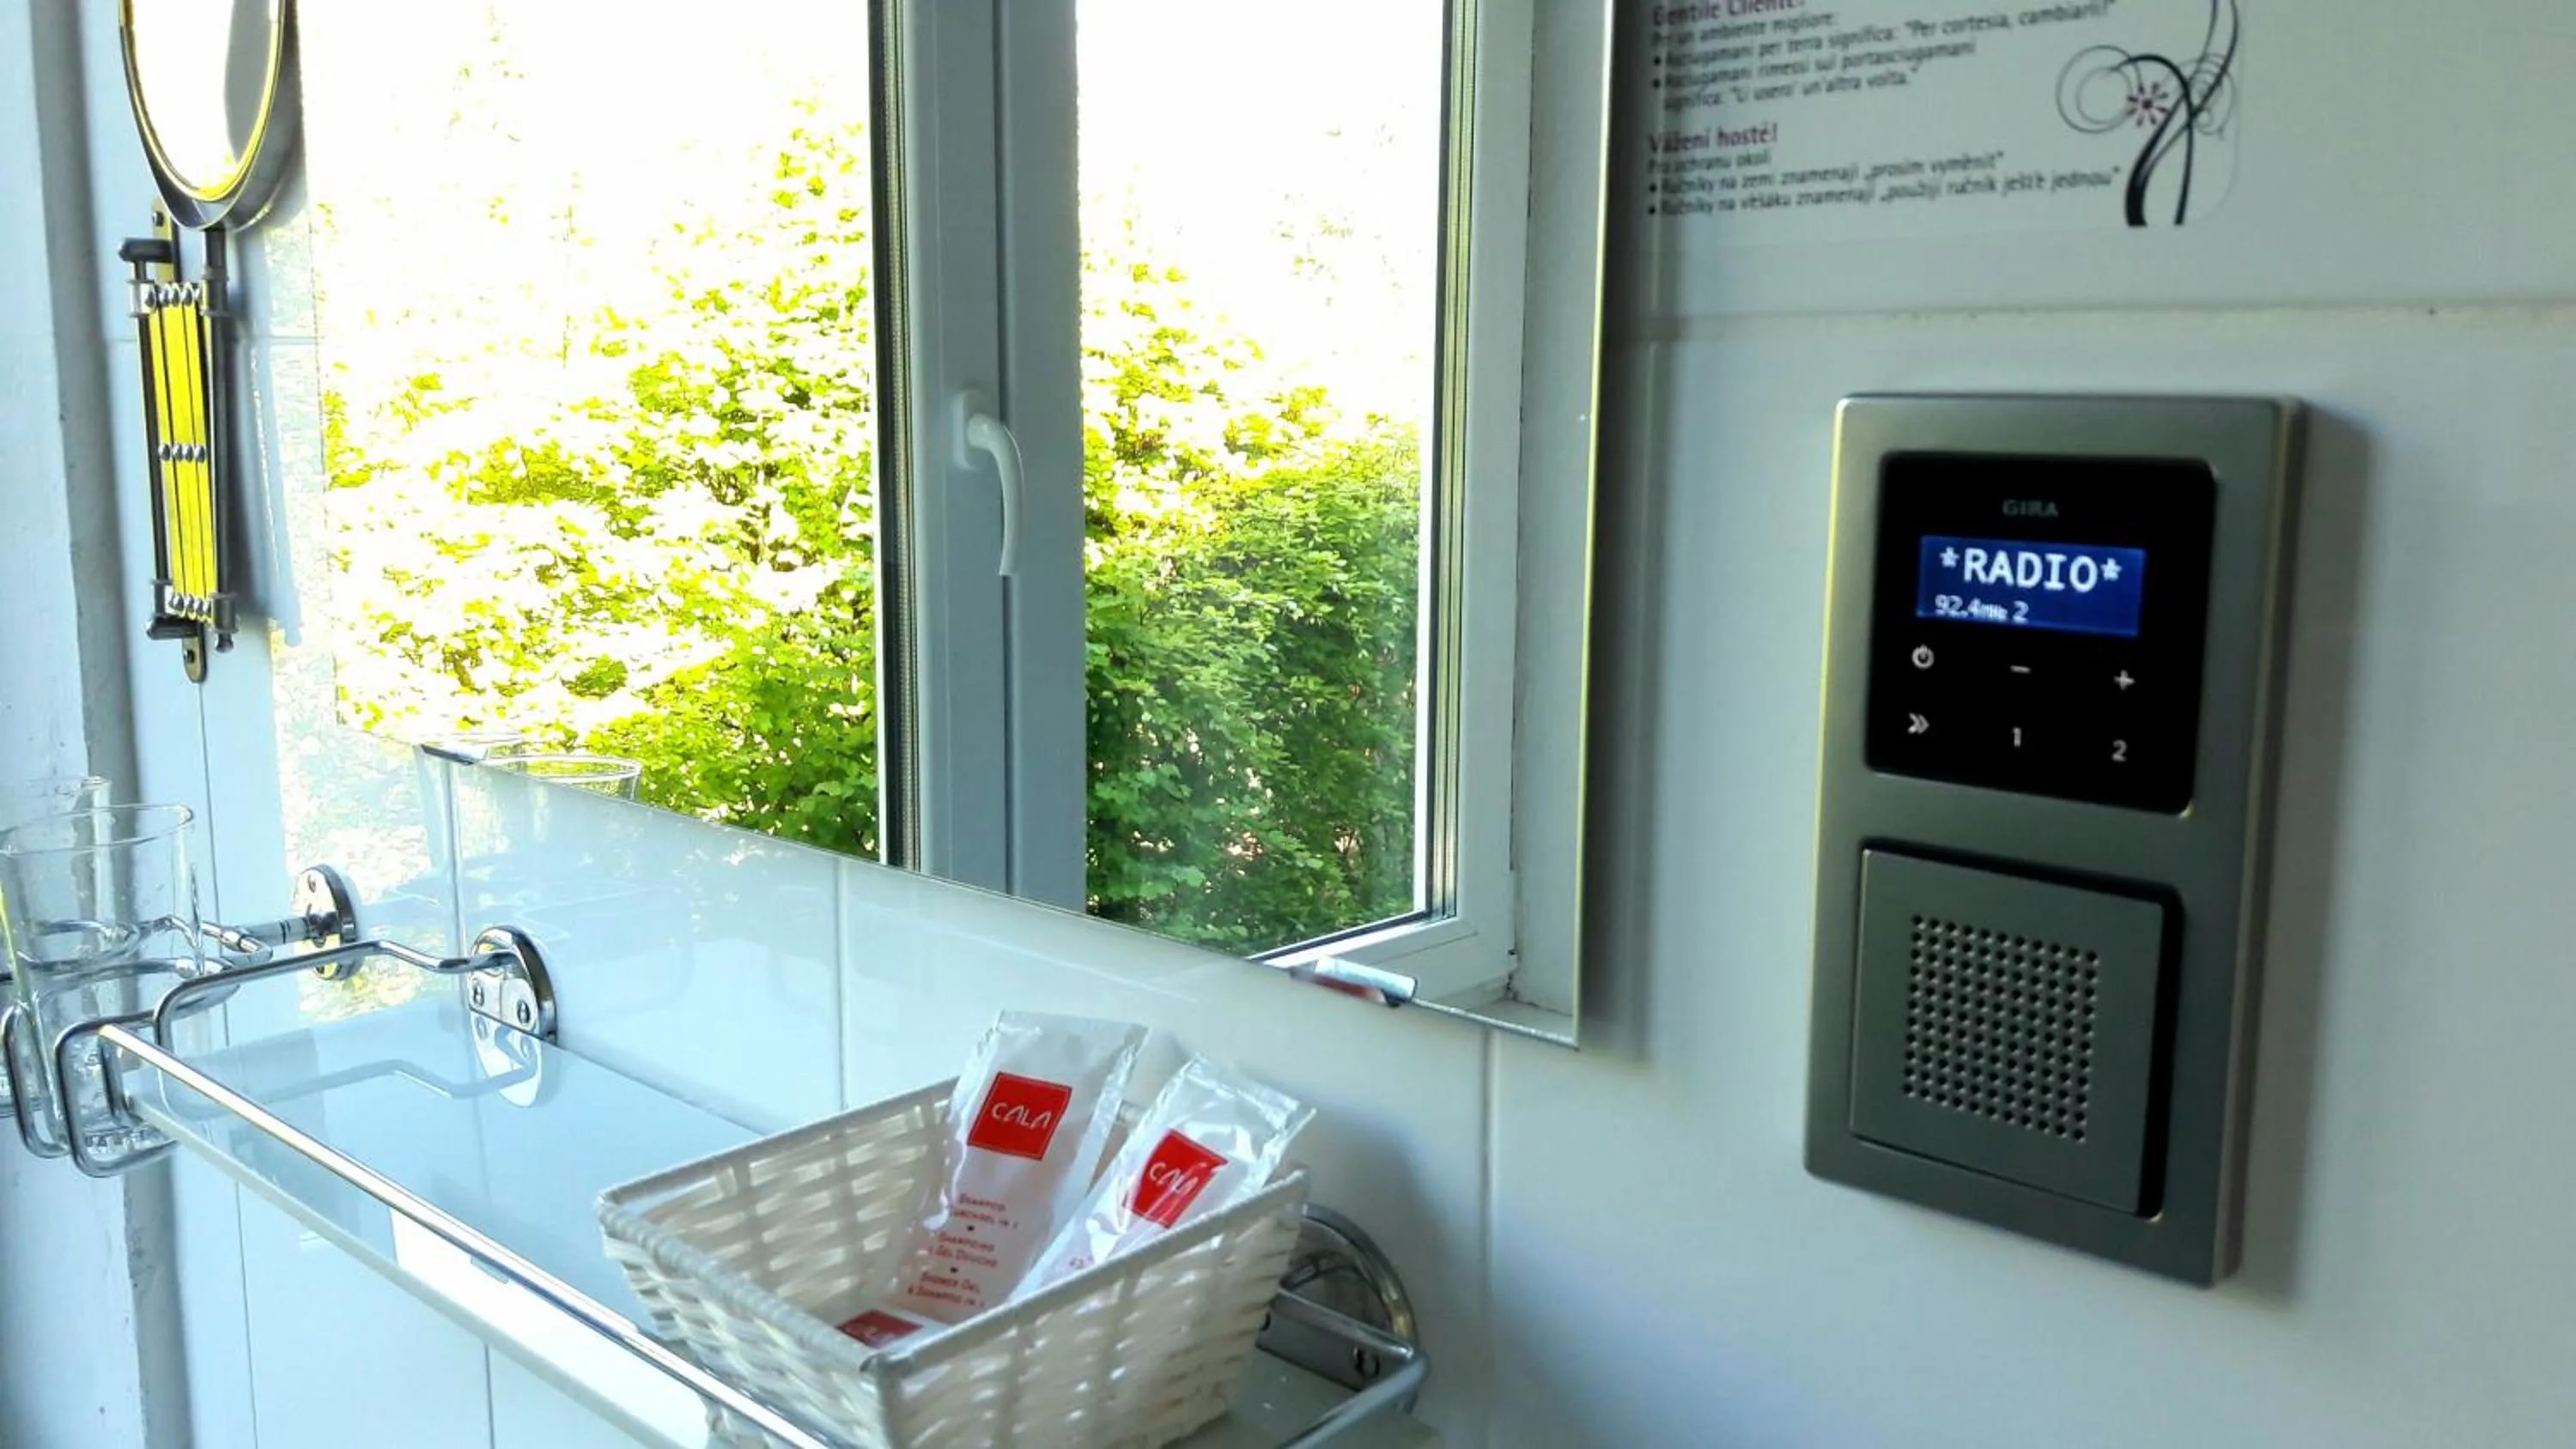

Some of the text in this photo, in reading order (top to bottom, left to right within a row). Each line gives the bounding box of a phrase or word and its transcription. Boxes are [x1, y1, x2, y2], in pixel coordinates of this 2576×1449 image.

[2002, 499, 2060, 517] GIRA
[2013, 600, 2030, 624] 2
[2012, 726, 2023, 749] 1
[2111, 739, 2129, 762] 2
[991, 1101, 1052, 1131] CALA
